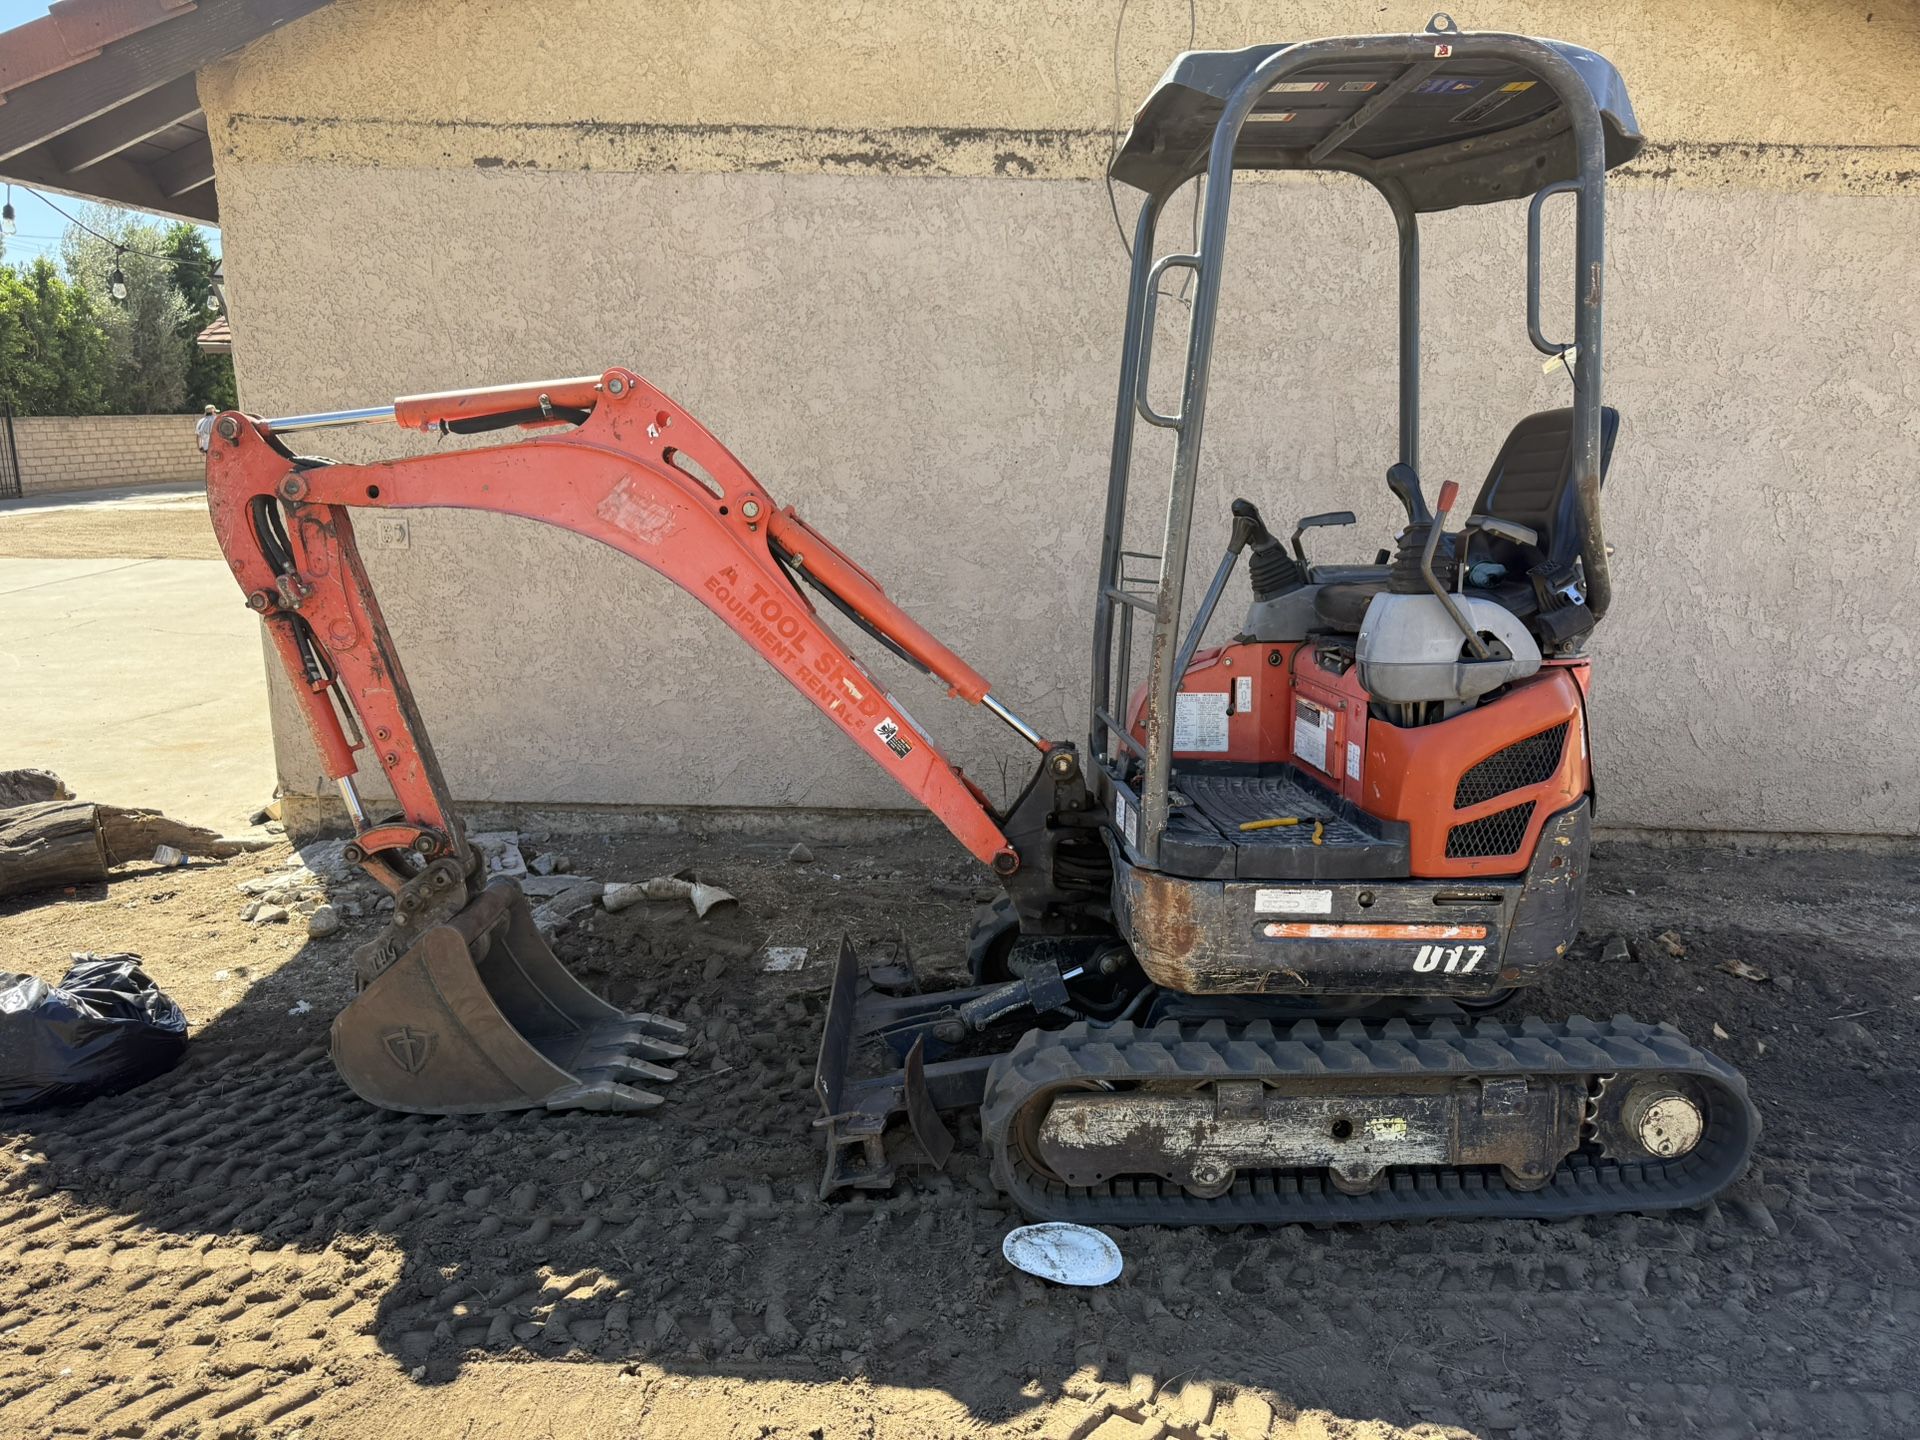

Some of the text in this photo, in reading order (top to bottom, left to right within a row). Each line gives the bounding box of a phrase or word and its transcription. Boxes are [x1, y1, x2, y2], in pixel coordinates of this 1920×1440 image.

[703, 575, 796, 664] EQUIPMENT
[748, 582, 808, 653] TOOL
[1412, 945, 1487, 973] U17
